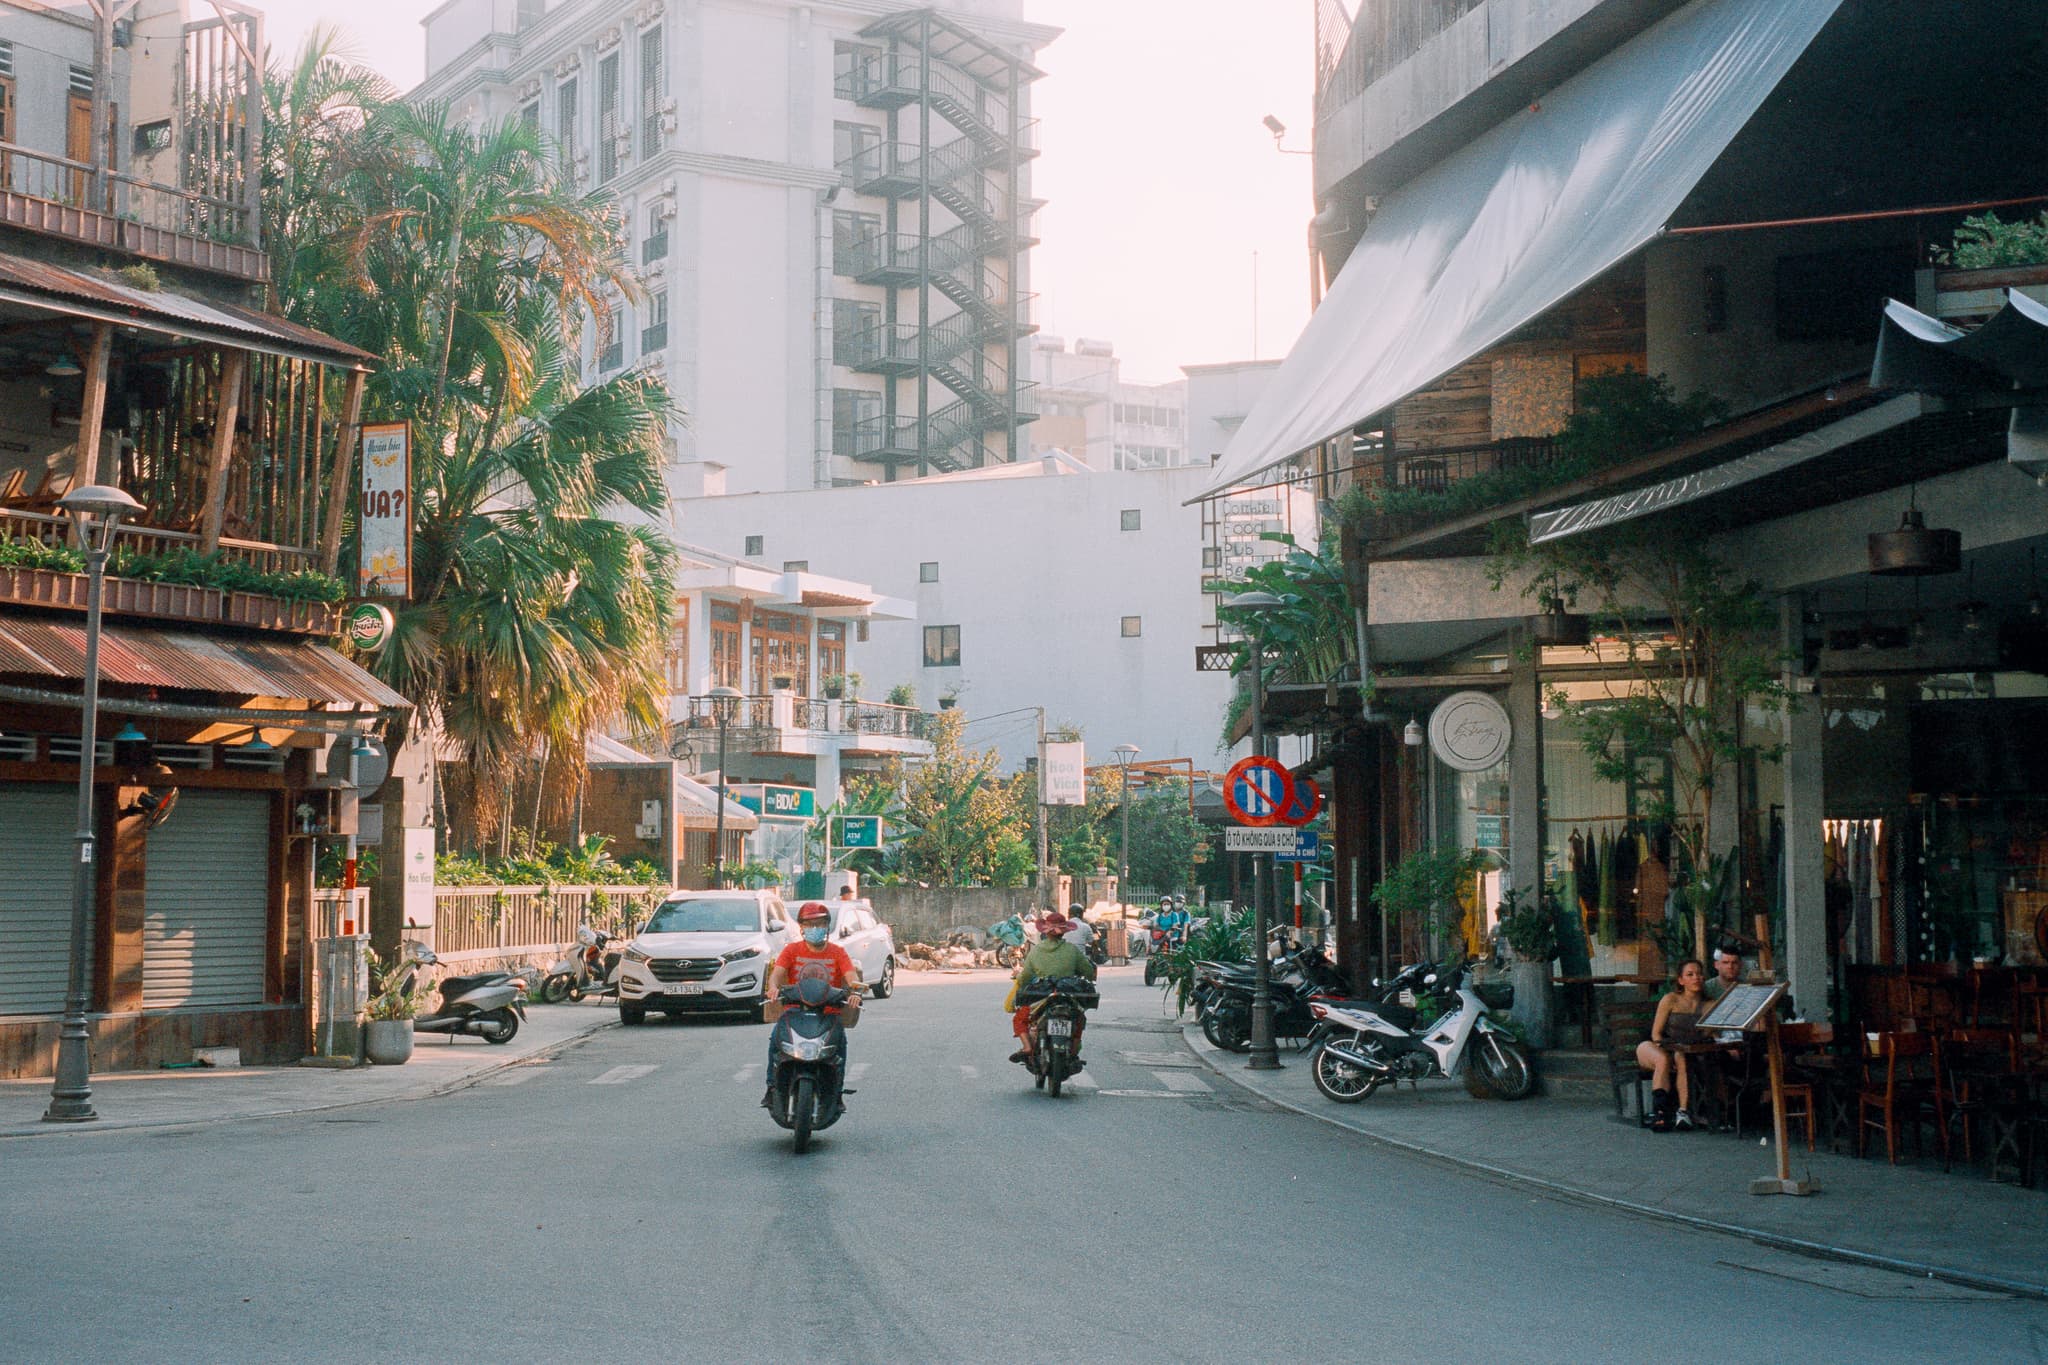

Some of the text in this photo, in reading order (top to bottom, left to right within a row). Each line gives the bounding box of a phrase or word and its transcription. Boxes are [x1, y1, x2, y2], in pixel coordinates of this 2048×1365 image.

[362, 478, 404, 518] ỦA?
[1224, 521, 1264, 534] Food
[1242, 829, 1263, 847] KHÔNG
[1277, 833, 1281, 847] 9
